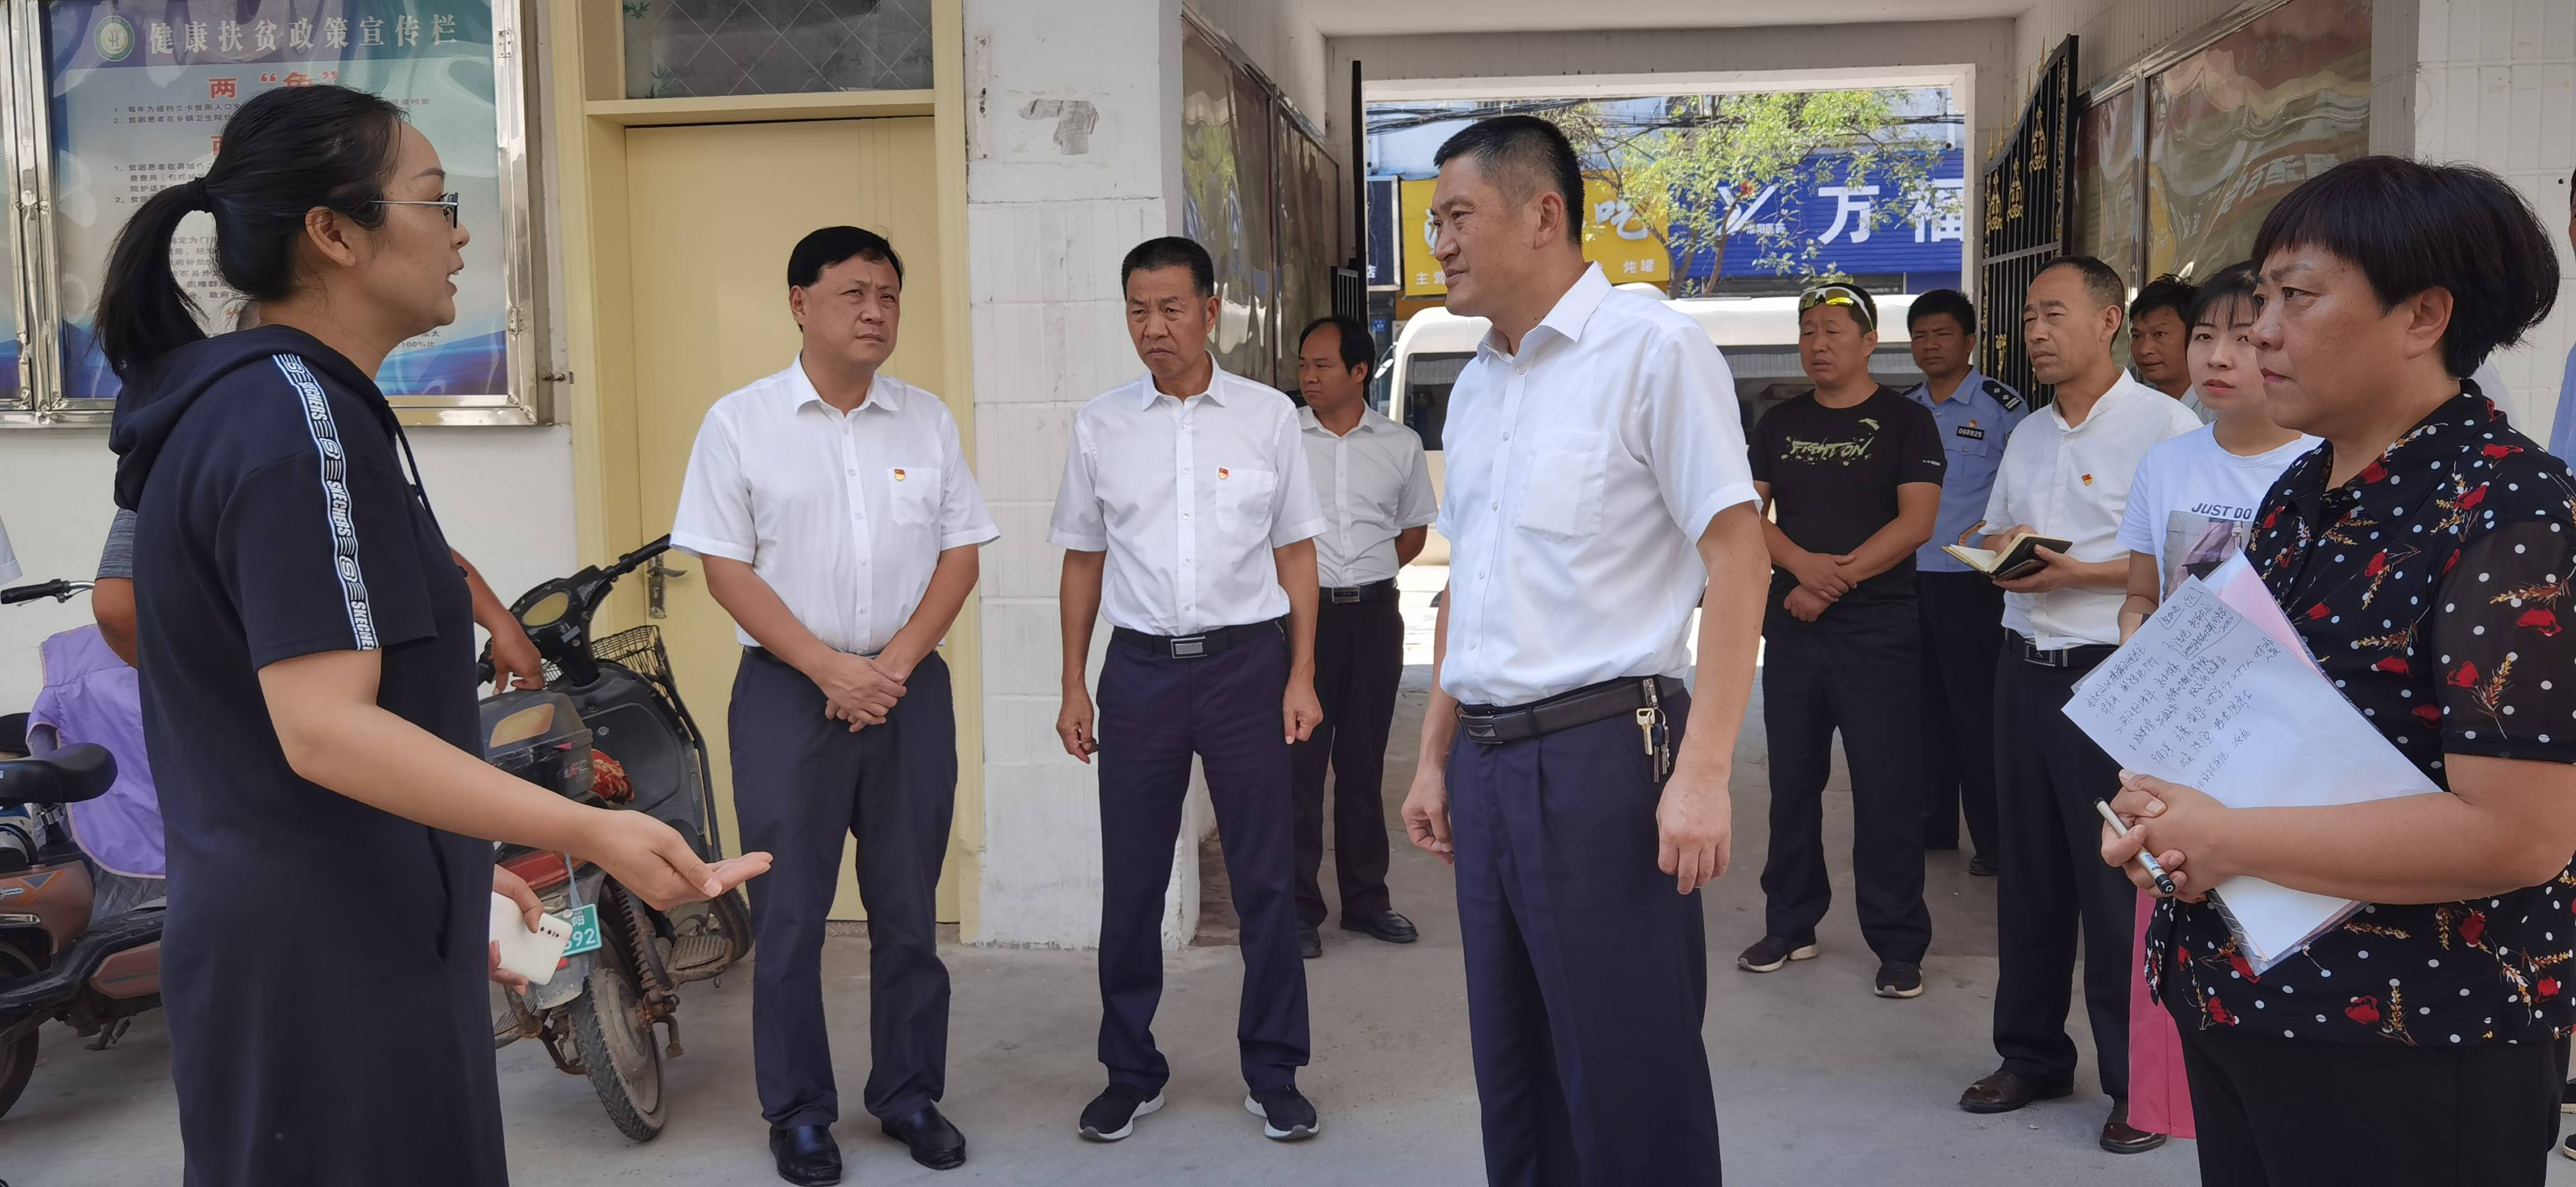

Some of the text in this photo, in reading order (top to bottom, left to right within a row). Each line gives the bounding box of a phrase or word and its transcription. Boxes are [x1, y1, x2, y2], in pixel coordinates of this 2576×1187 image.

[150, 14, 456, 55] 健康扶贫政策宣传栏
[1818, 178, 1963, 245] 万福
[2191, 502, 2233, 516] JUST
